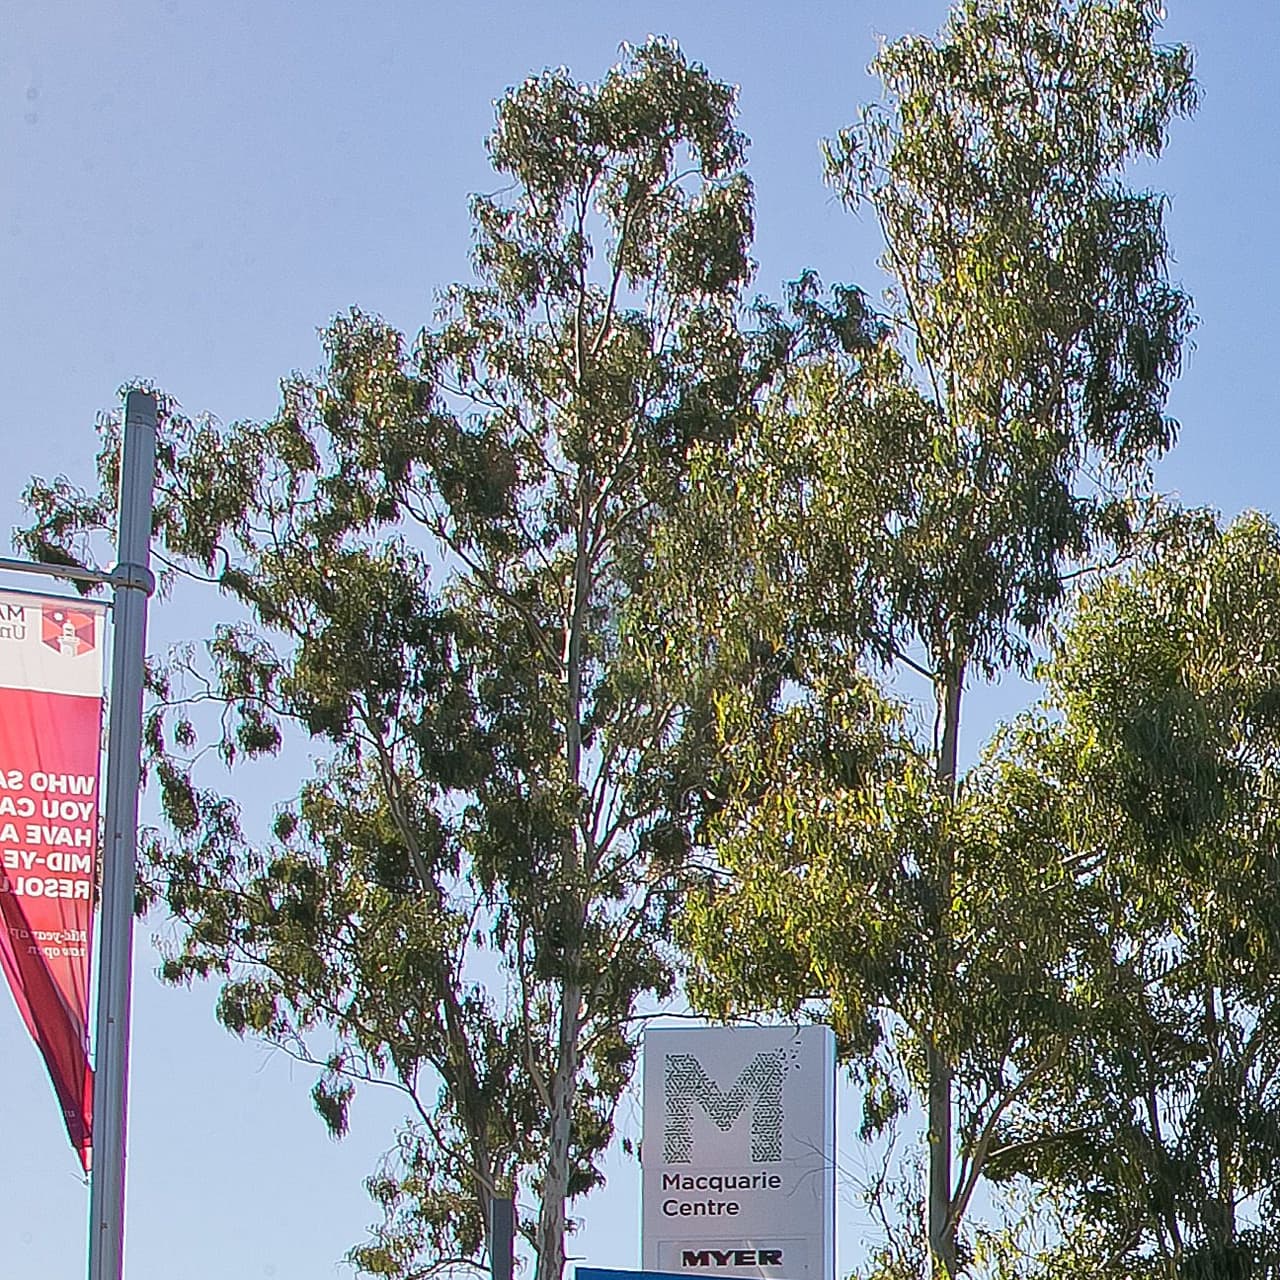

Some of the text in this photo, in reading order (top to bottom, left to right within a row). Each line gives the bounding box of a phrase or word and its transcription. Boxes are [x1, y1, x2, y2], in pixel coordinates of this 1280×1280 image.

[663, 1051, 785, 1164] M
[662, 1171, 782, 1195] Macquarie
[662, 1199, 741, 1217] Centre
[682, 1249, 783, 1268] MYER
